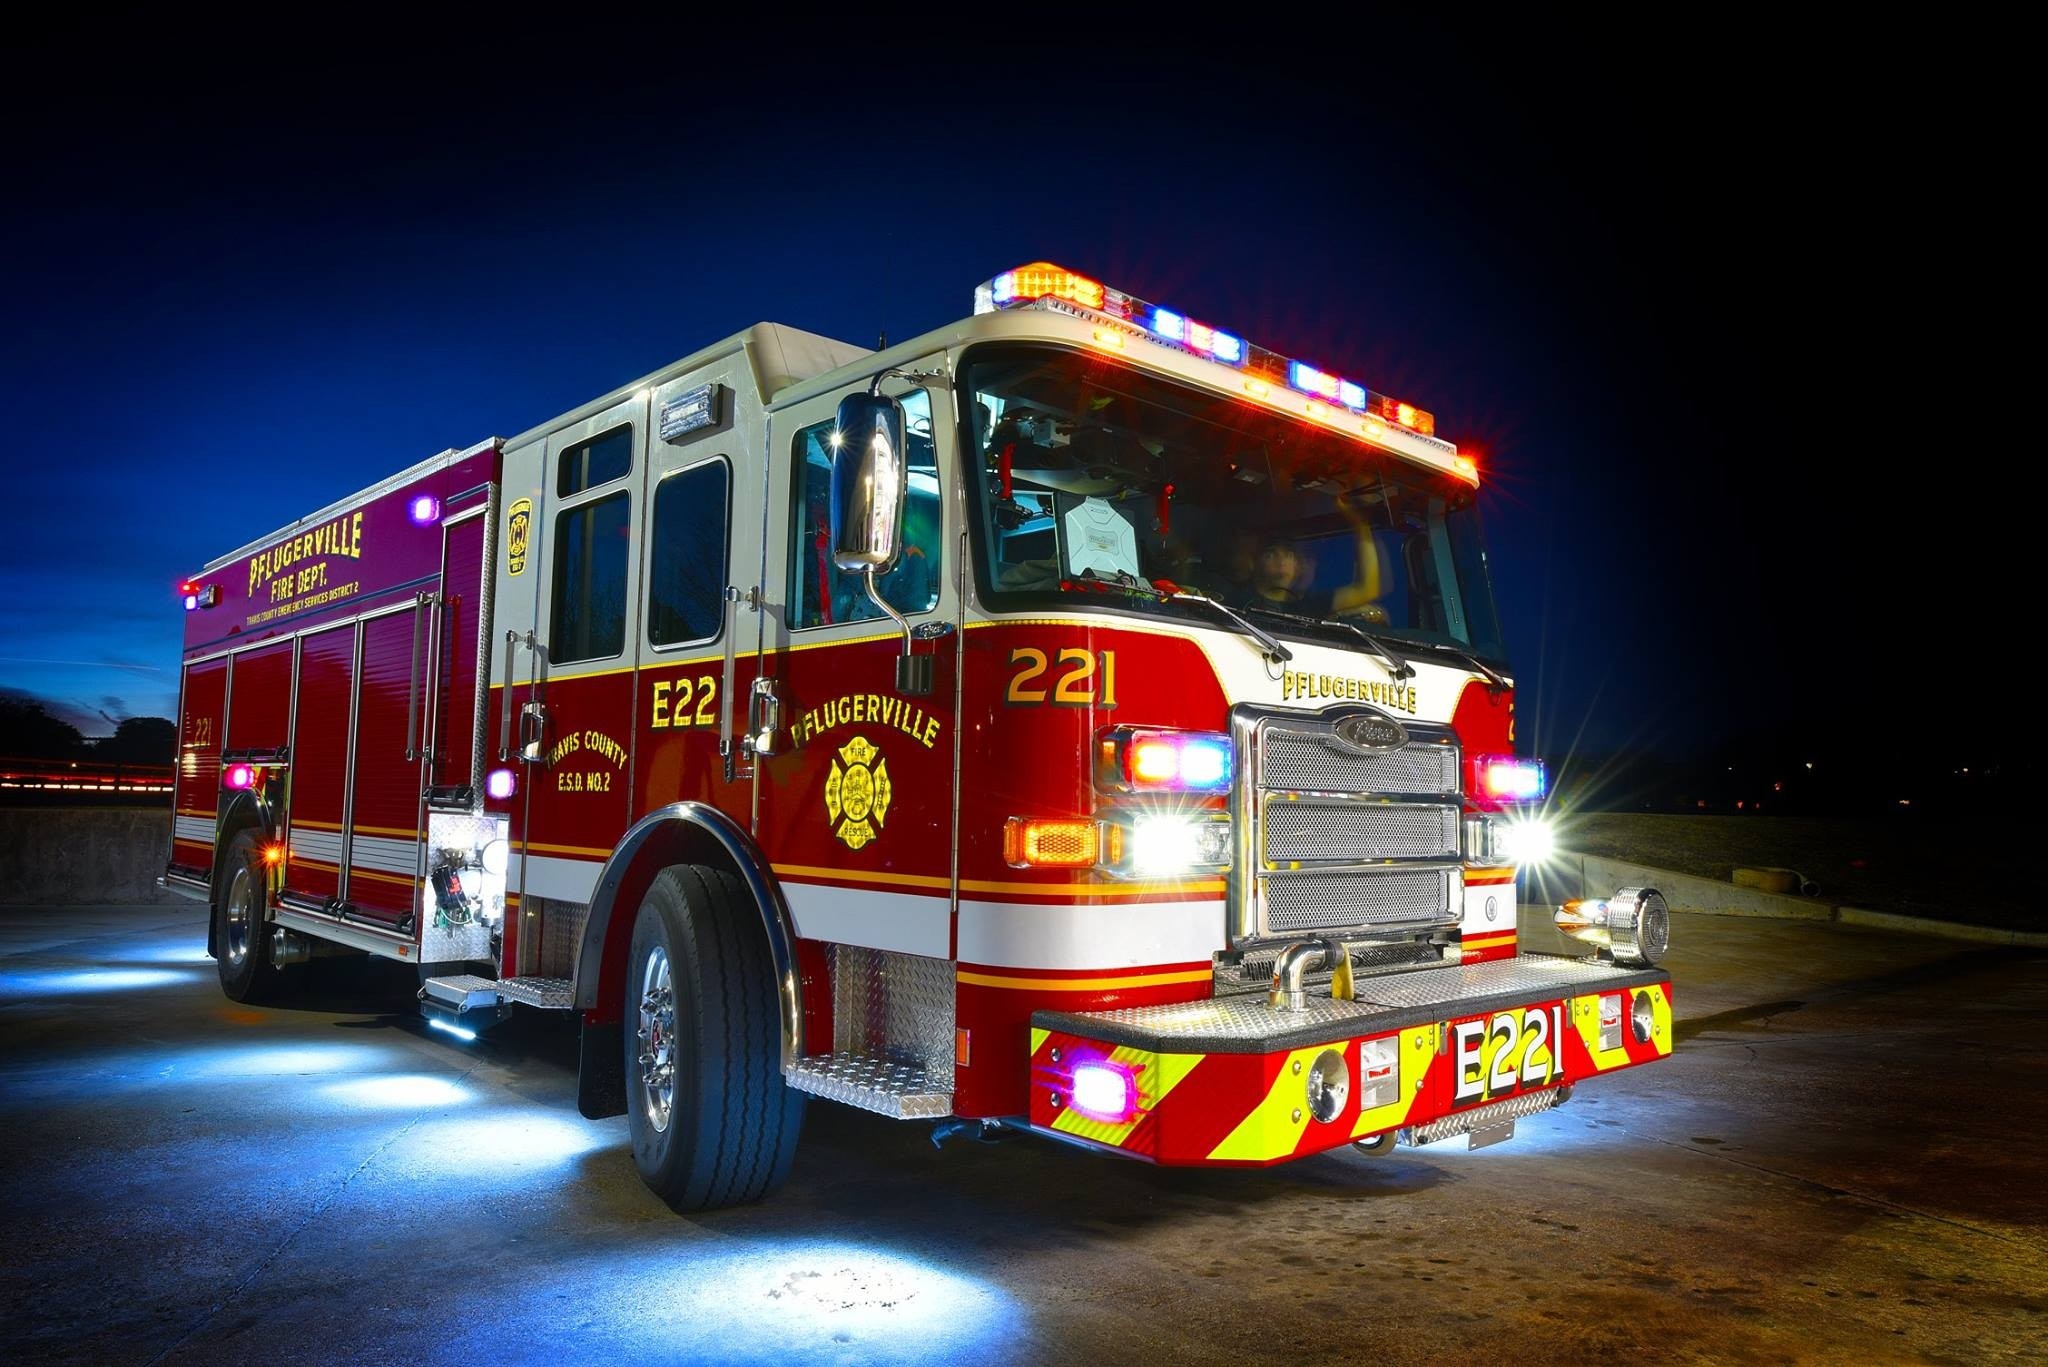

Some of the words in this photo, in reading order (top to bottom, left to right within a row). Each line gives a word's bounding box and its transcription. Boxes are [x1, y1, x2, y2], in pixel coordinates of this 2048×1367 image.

[248, 512, 363, 598] PFLUGERVILLE
[270, 574, 294, 603] FIRE
[297, 562, 327, 594] DEPT.
[304, 591, 328, 608] SERVICES
[329, 583, 353, 600] DISTRICT
[354, 581, 359, 593] 2
[1006, 647, 1117, 705] 221
[1283, 670, 1417, 714] PFLUGERVILLE
[652, 675, 725, 728] E22
[790, 694, 941, 749] PFLUGERVILLE
[194, 717, 212, 746] 221
[544, 731, 580, 769] TRAVIS
[584, 730, 628, 770] COUNTY
[851, 747, 866, 757] FIRE
[558, 772, 583, 792] E.S.D.
[844, 826, 869, 838] RESCUE
[1453, 1005, 1565, 1101] E221
